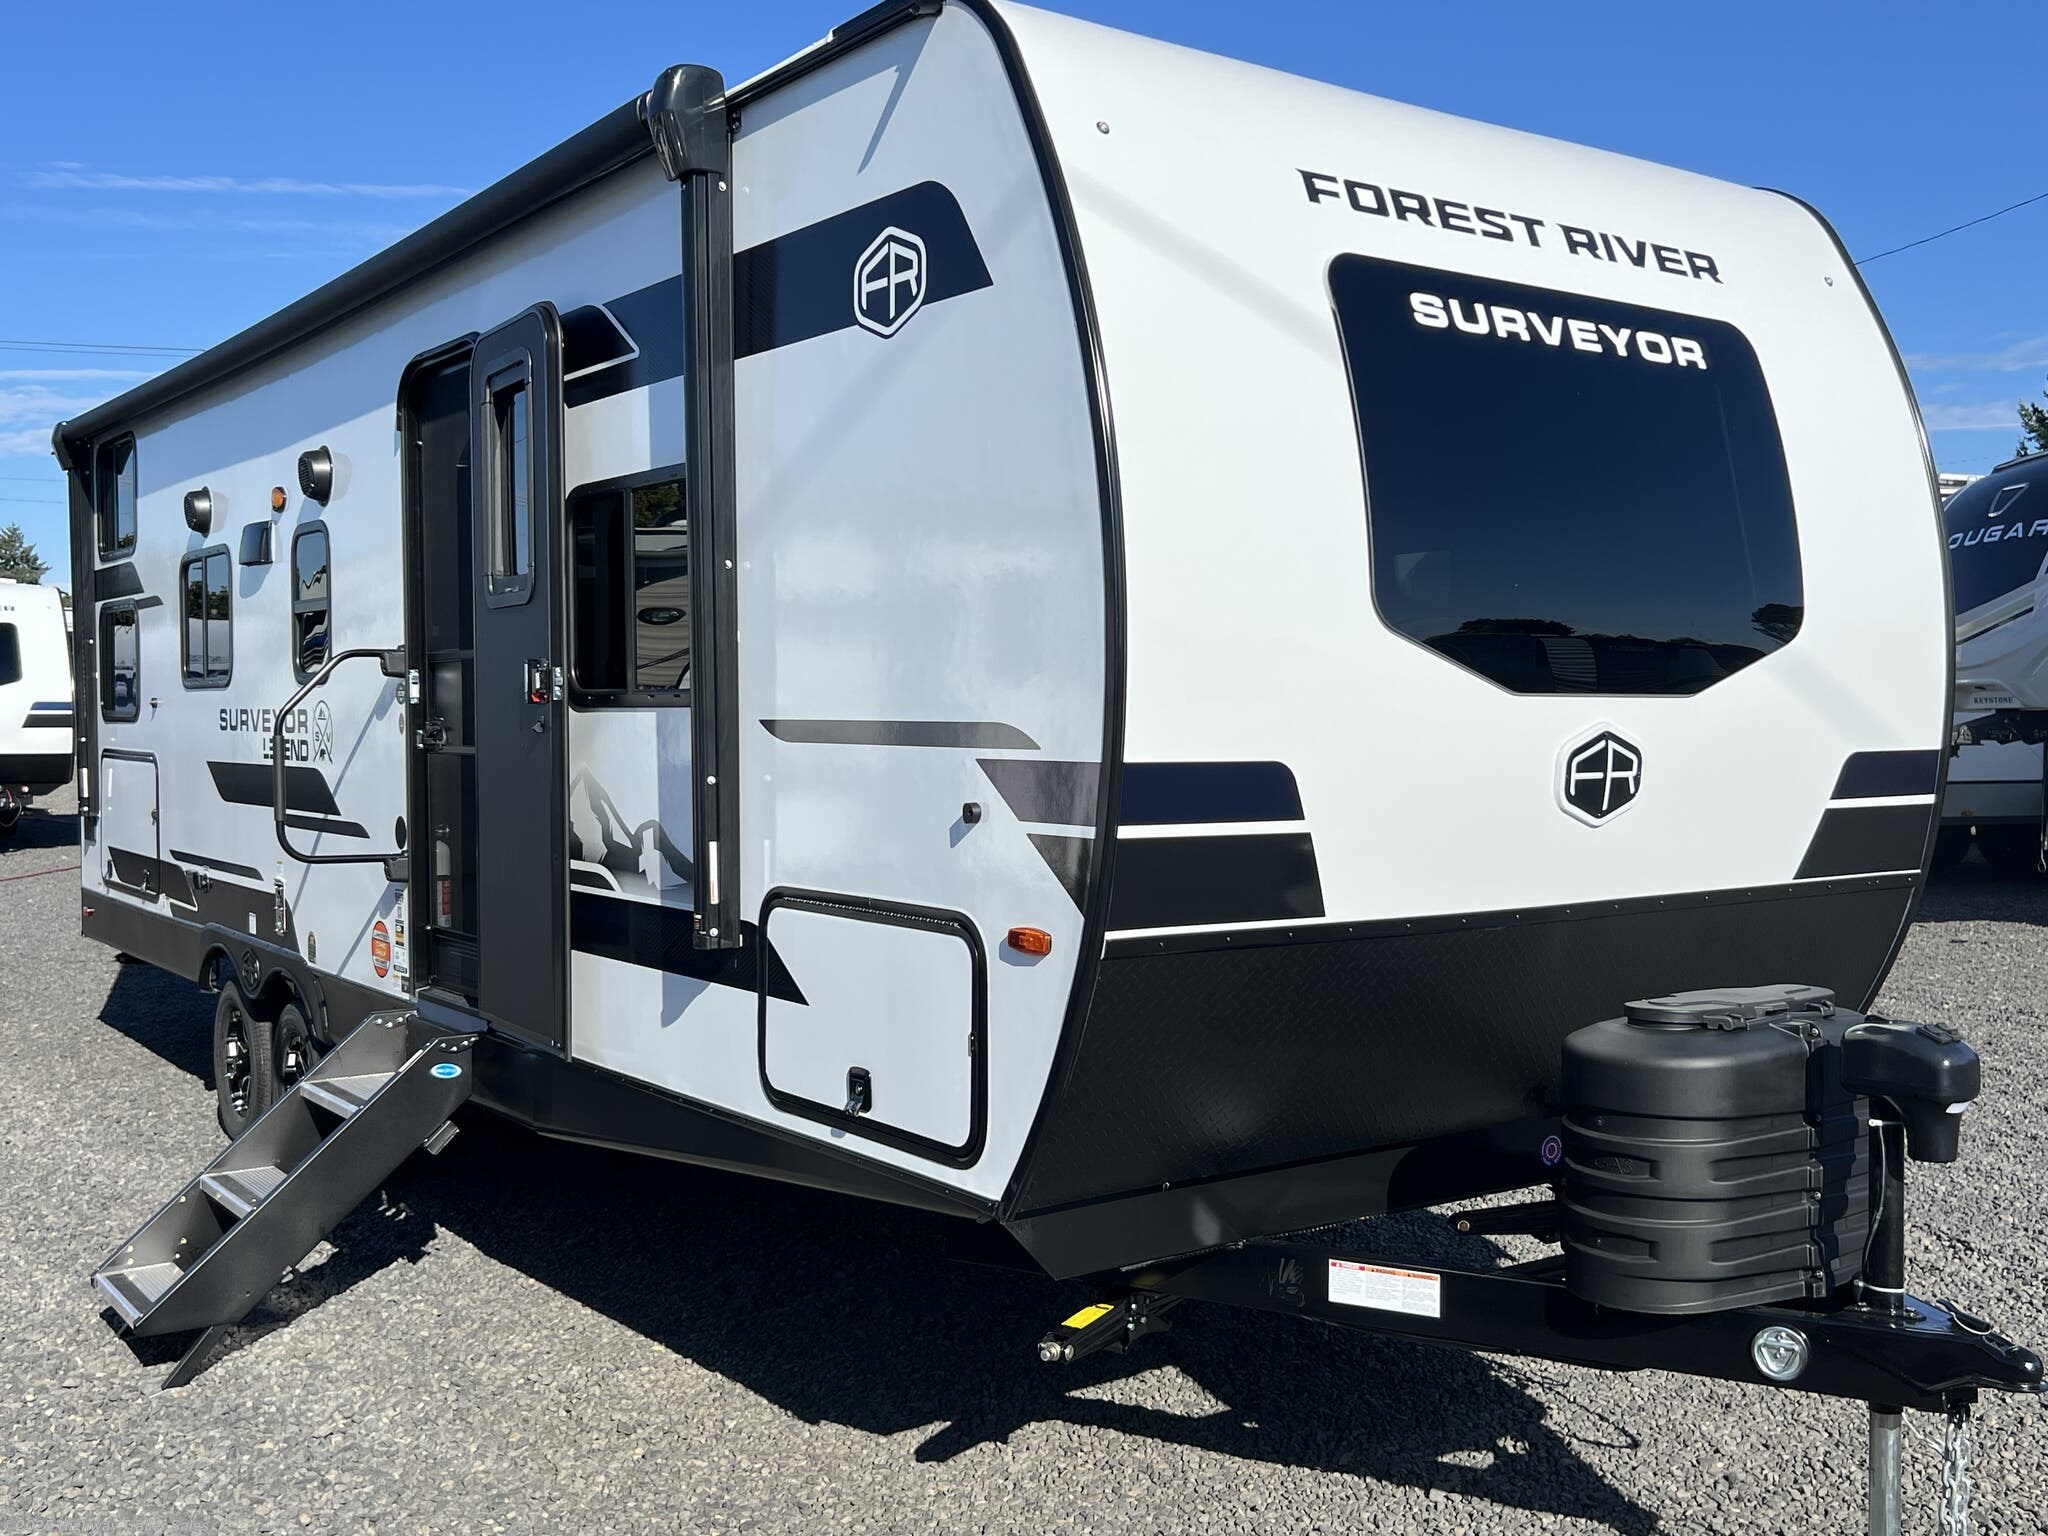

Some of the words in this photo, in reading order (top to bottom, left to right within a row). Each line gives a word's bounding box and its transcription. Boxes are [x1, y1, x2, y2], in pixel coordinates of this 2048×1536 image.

[1294, 168, 1545, 247] FOREST
[1556, 223, 1724, 284] RIVER
[1409, 292, 1708, 370] SURVEYOR
[1948, 518, 2048, 550] OUGAR
[1974, 696, 2012, 704] KEYSTONE
[219, 708, 308, 734] SURVEOR
[262, 738, 309, 761] LEEND
